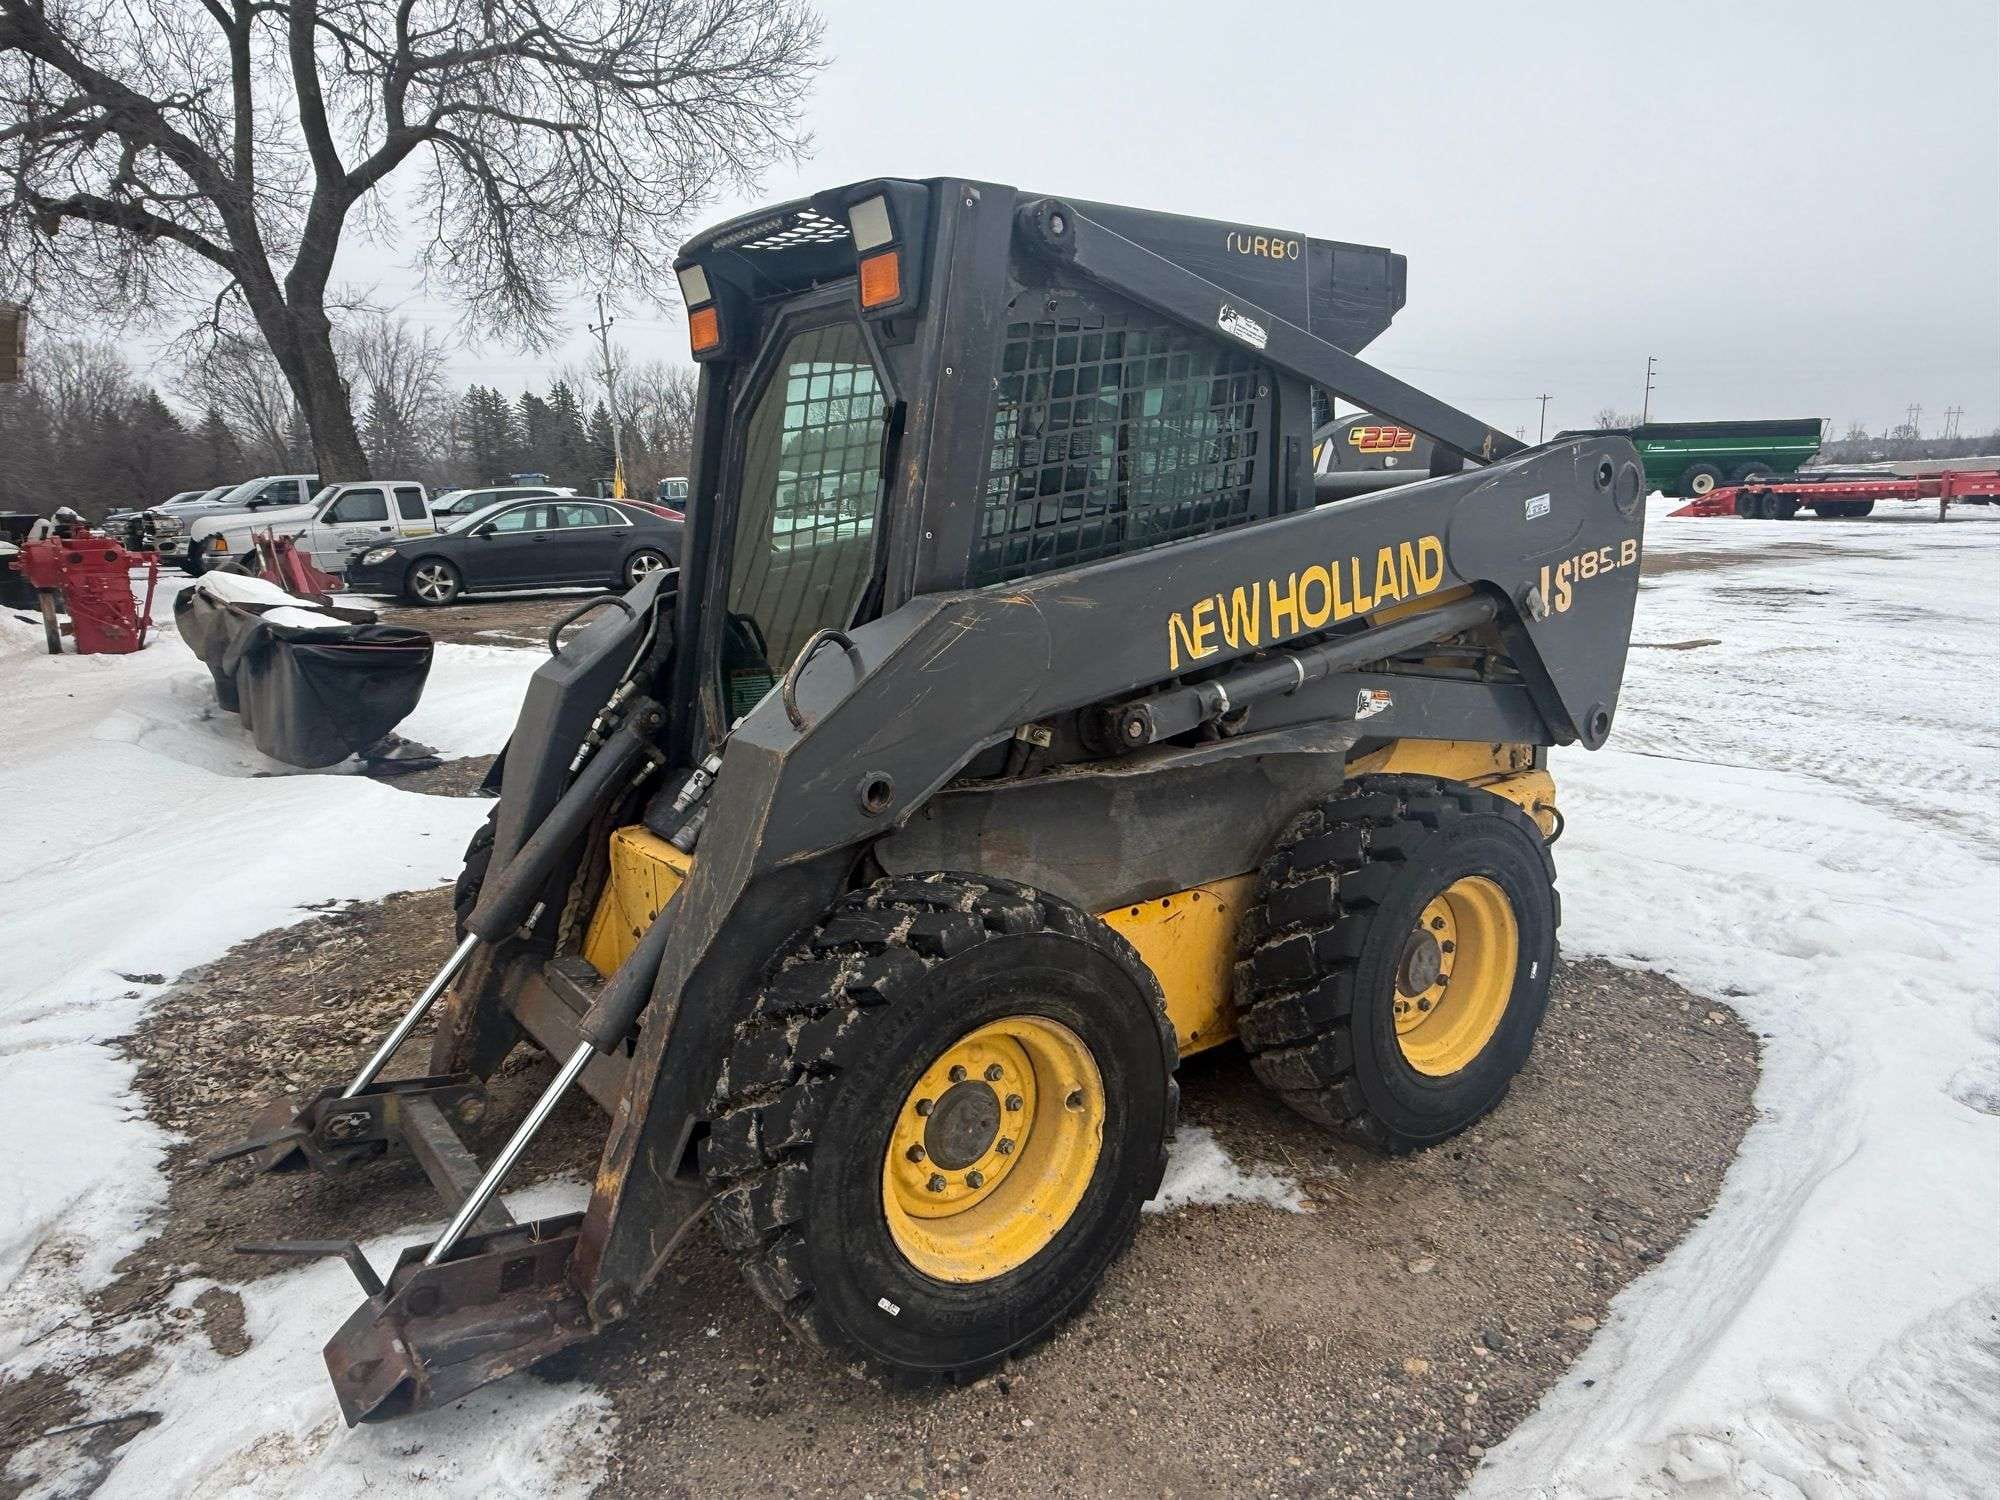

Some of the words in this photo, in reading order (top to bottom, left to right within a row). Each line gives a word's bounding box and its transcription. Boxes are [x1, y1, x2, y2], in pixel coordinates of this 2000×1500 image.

[1226, 231, 1299, 261] TURBO
[1168, 582, 1261, 672] NEW
[1268, 535, 1445, 639] HOLLAND
